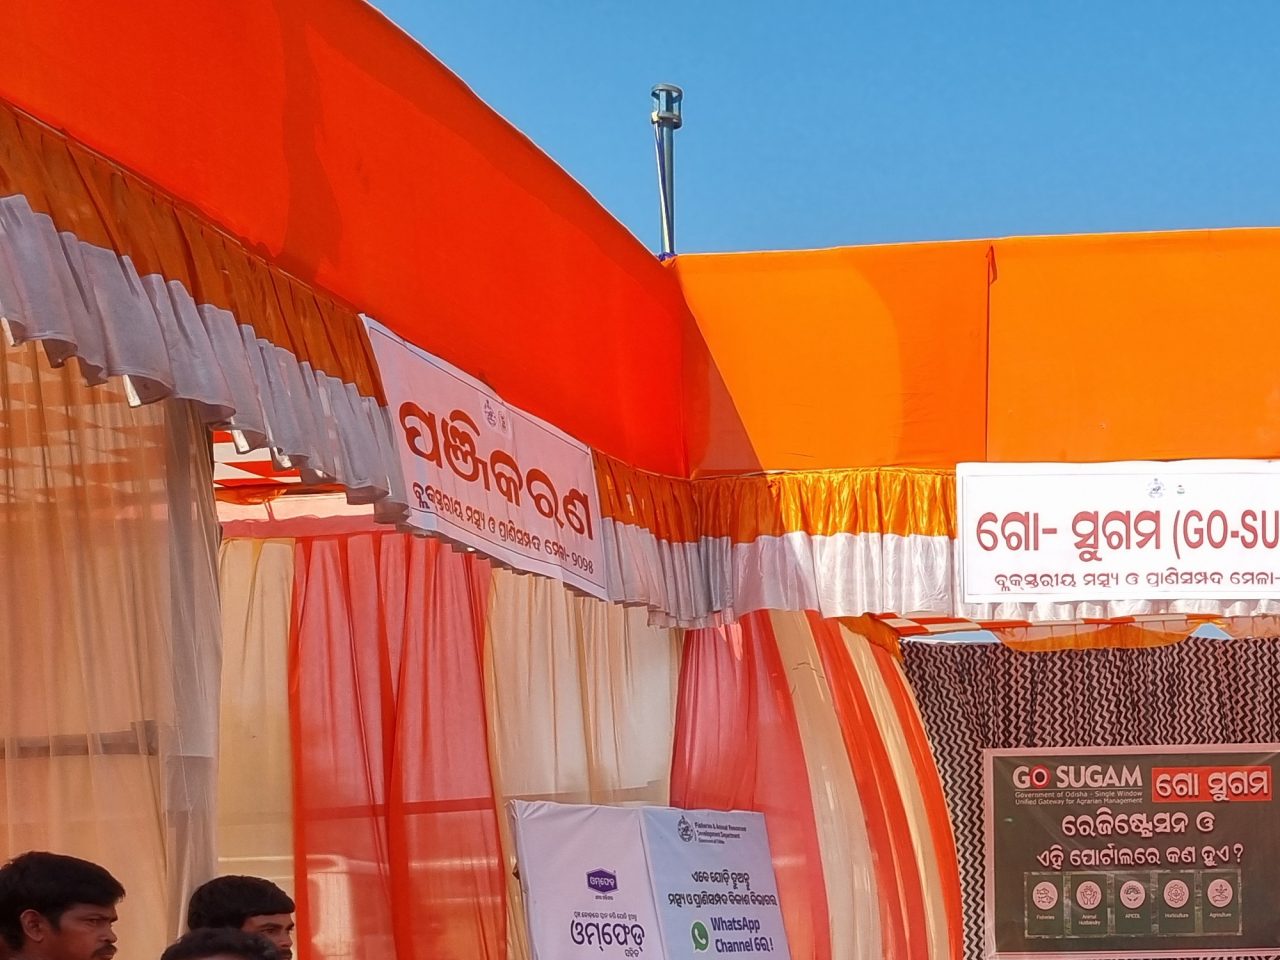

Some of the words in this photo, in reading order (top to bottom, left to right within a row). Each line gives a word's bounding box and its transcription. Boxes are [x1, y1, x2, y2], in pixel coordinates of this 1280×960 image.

[488, 516, 496, 534] ଓ
[499, 520, 541, 551] ପ୍ରାଣିସମ୍ପଦ
[571, 552, 594, 575] ୨୦୨୫
[1071, 509, 1161, 562] ସୁଗମ
[1083, 573, 1119, 588] ମତ୍ସ୍ୟ
[1125, 573, 1139, 586] ଓ
[1146, 567, 1223, 588] ପ୍ରାଣିସମ୍ପଦ
[1012, 765, 1048, 789] GO
[1056, 764, 1143, 788] SUGAM
[1156, 773, 1199, 797] ଗୋ
[1208, 770, 1269, 801] ସୁଗମ
[1015, 791, 1055, 799] Government
[1094, 790, 1115, 799] Single
[1038, 798, 1064, 806] Gateway
[1076, 798, 1102, 806] Agrarian
[1103, 797, 1143, 805] Management
[1196, 811, 1216, 832] ଓ
[1036, 844, 1064, 869] ଏହି
[1070, 843, 1160, 866] ପୋର୍ଟାଲରେ
[1166, 846, 1196, 863] କଣ
[1201, 845, 1229, 867] ହୁଏ
[710, 917, 760, 933] WhatsApp
[715, 938, 754, 953] Channel
